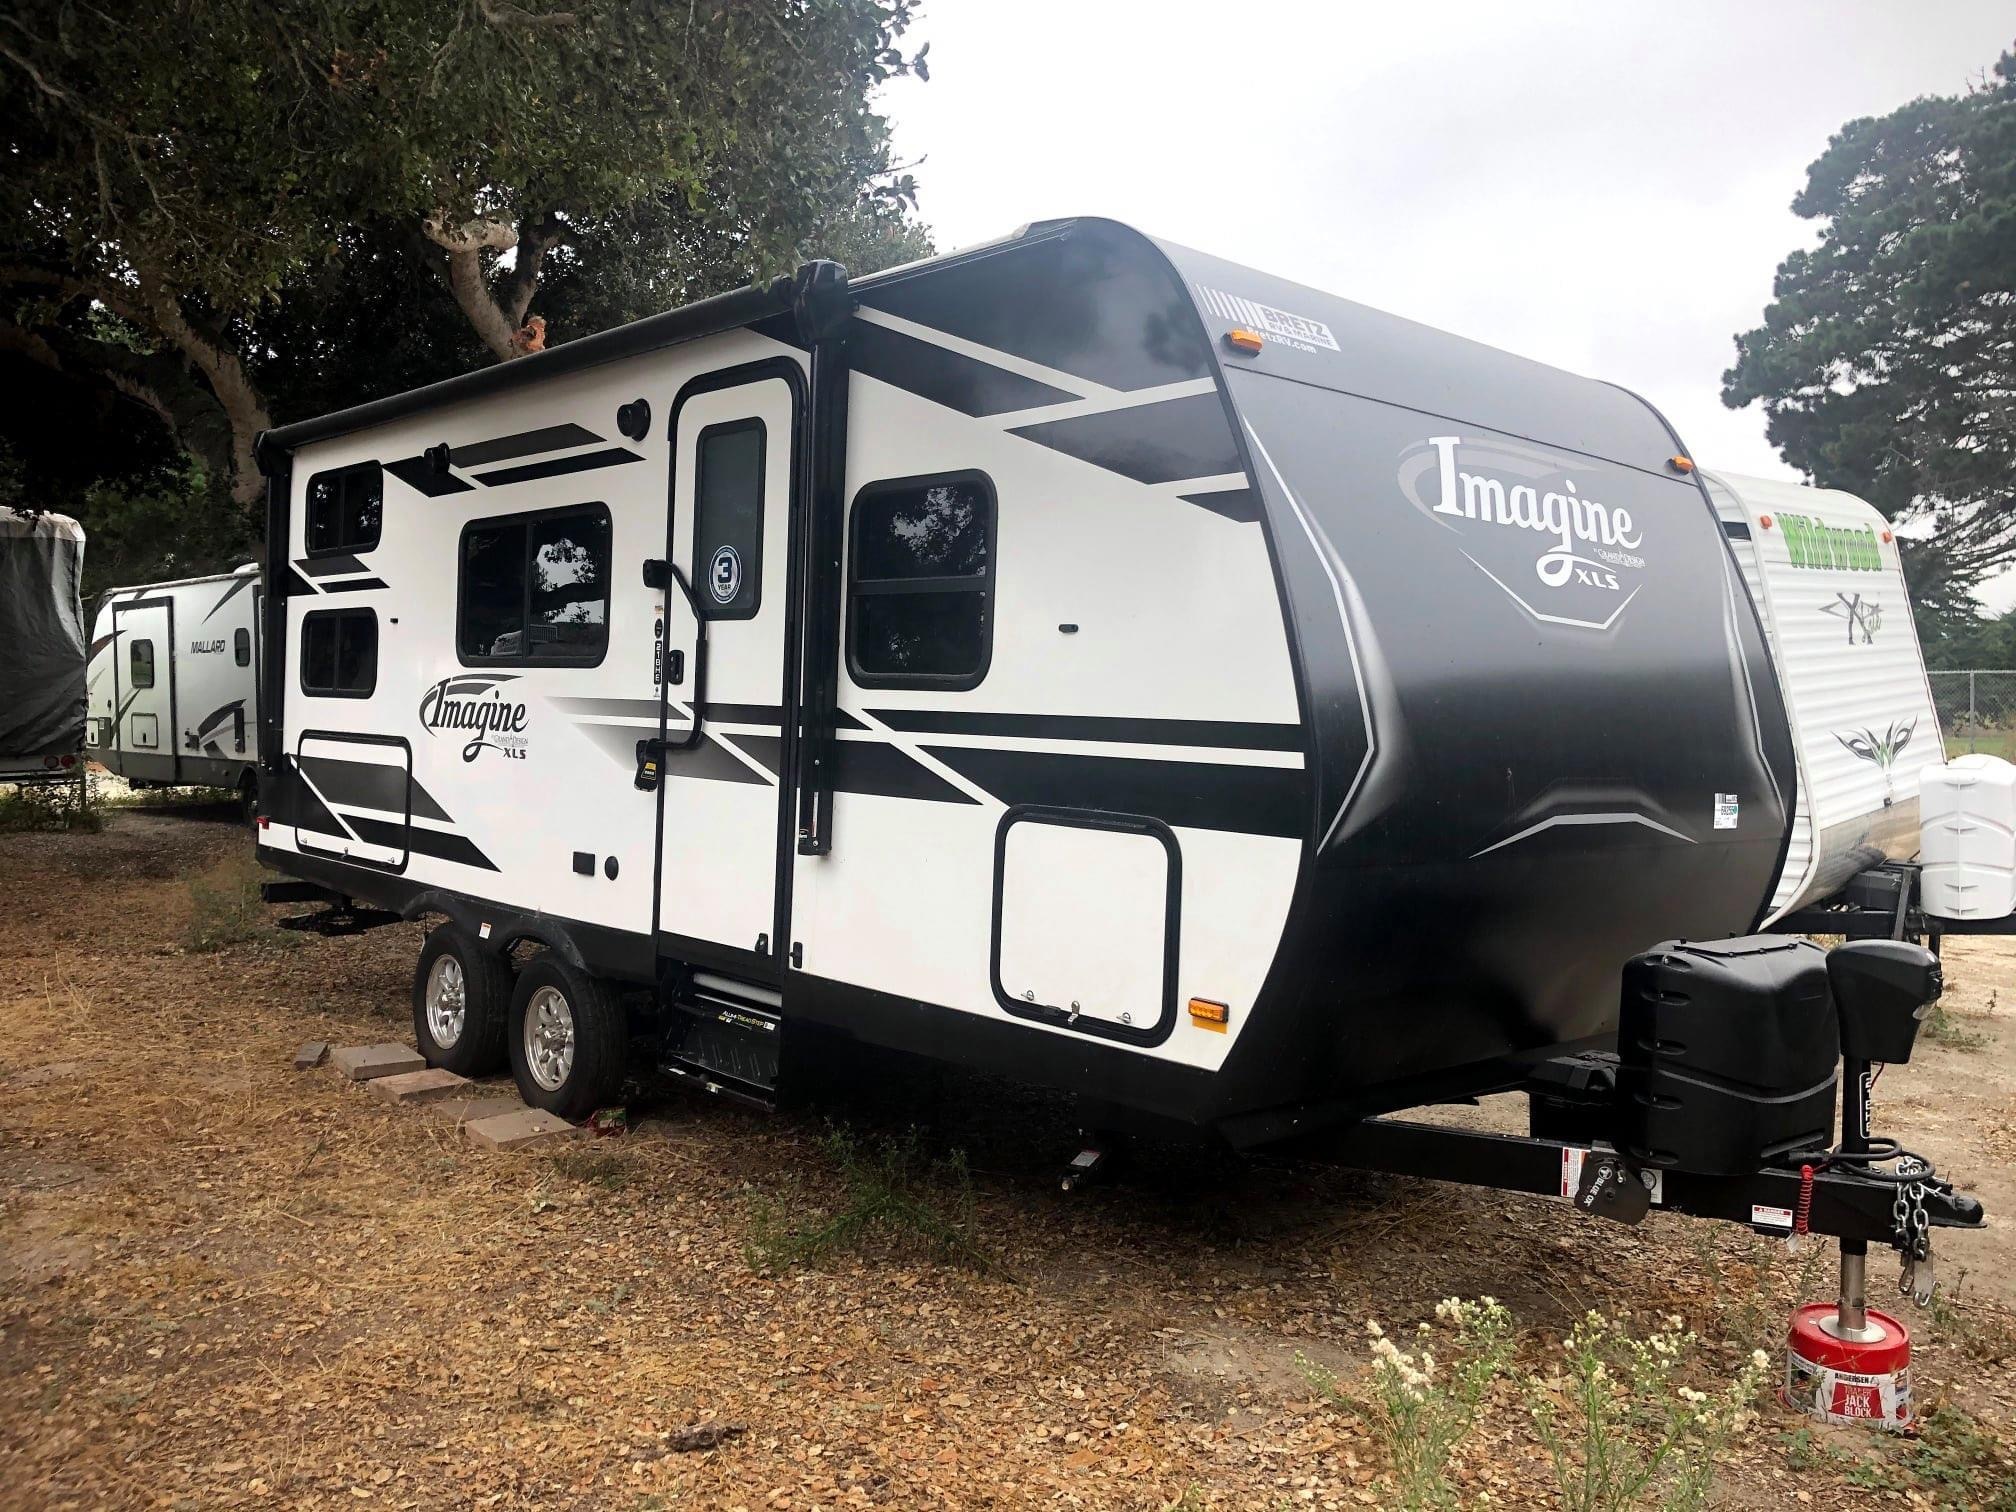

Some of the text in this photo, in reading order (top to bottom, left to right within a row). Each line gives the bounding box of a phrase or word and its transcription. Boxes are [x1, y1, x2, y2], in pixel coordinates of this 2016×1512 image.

[1260, 306, 1329, 339] BRETZ
[1428, 436, 1643, 587] Imagine
[717, 556, 733, 584] 3
[1574, 568, 1620, 590] XLS
[717, 583, 732, 591] YEAR
[191, 639, 226, 654] MALLARD
[428, 677, 530, 763] Imagine
[502, 747, 527, 760] XLS
[1583, 1177, 1606, 1207] BLUE OX
[1834, 1373, 1869, 1385] ANDERSEN
[1844, 1394, 1871, 1408] JACK
[1844, 1405, 1872, 1418] BLOCK
